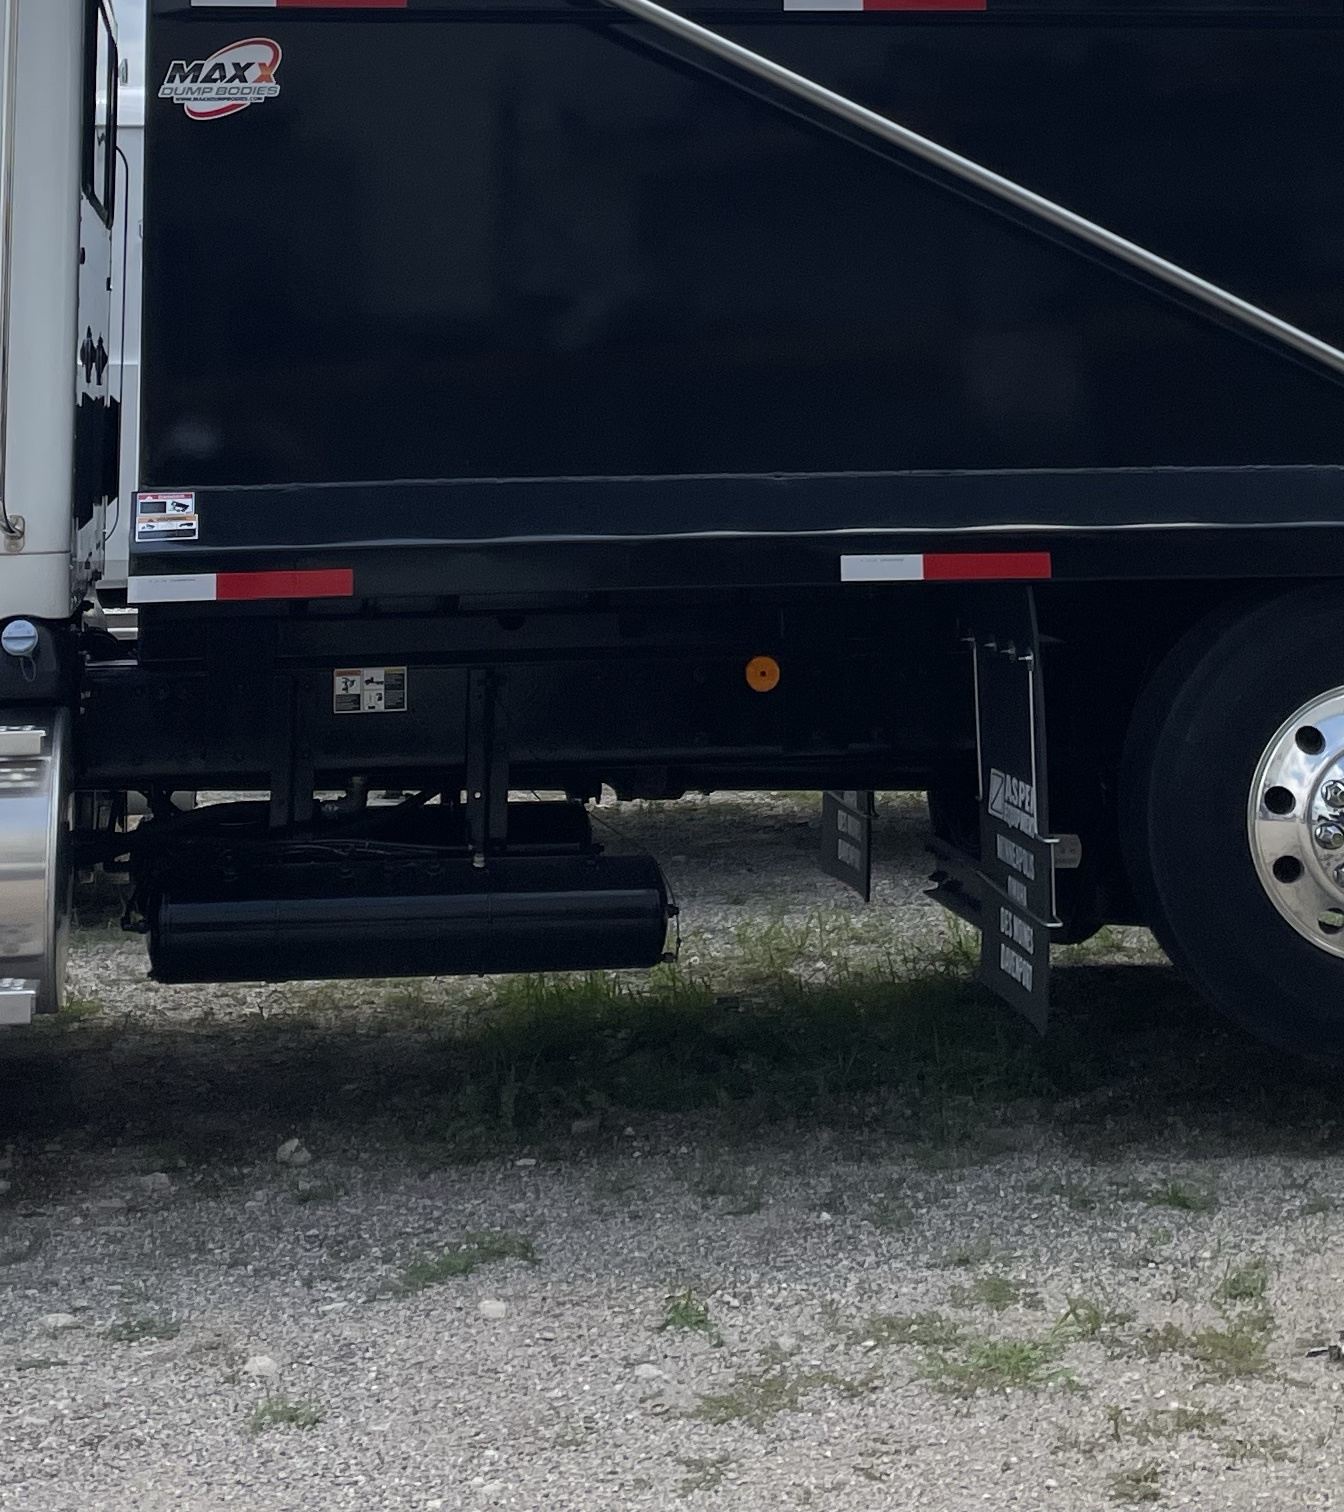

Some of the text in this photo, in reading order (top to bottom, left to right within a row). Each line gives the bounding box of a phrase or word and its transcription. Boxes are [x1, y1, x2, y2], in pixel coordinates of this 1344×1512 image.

[165, 62, 275, 84] MAXX
[160, 86, 279, 96] DUMP BODIES
